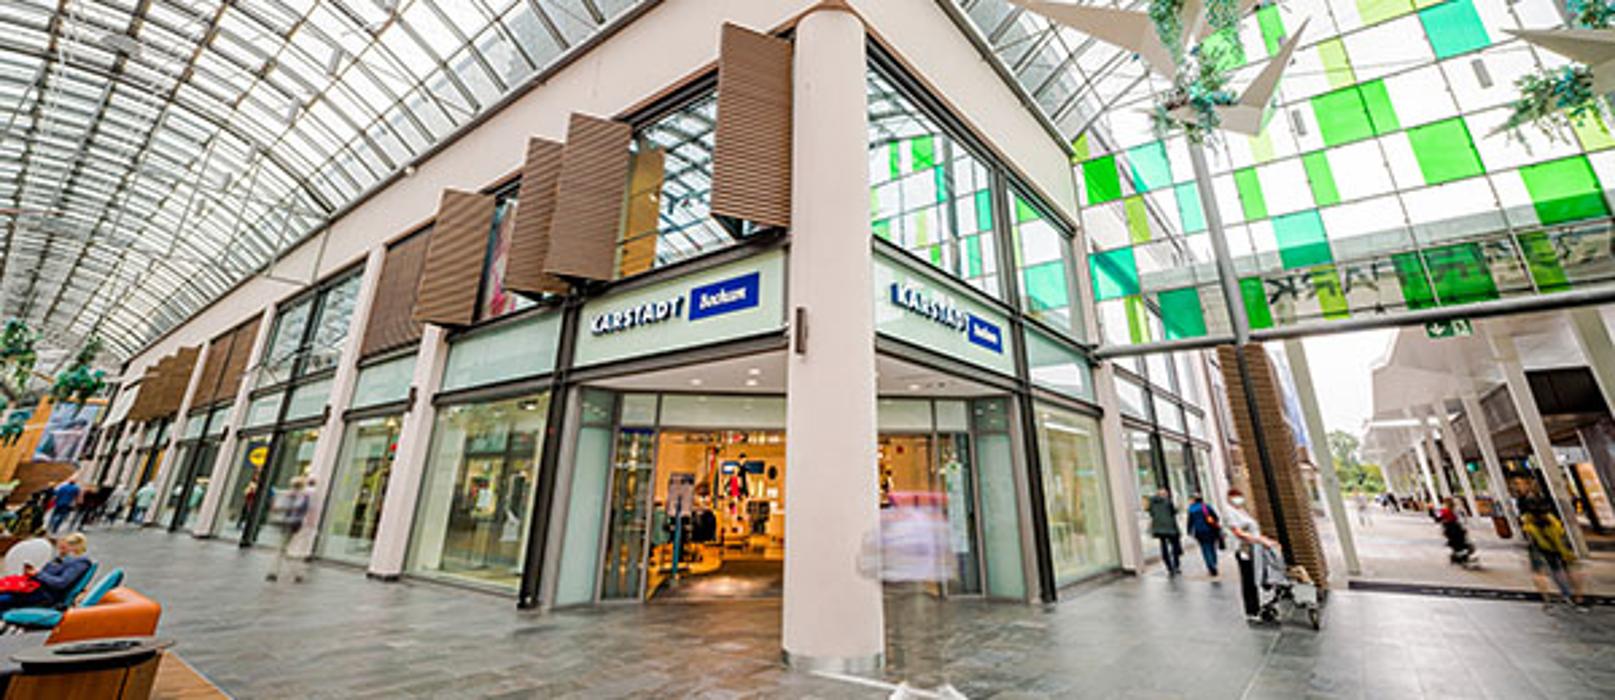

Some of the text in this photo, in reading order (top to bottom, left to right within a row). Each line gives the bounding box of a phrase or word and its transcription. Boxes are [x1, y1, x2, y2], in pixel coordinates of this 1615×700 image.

[590, 286, 747, 335] KARSTADT Bochum
[891, 283, 969, 332] KARSTAD
